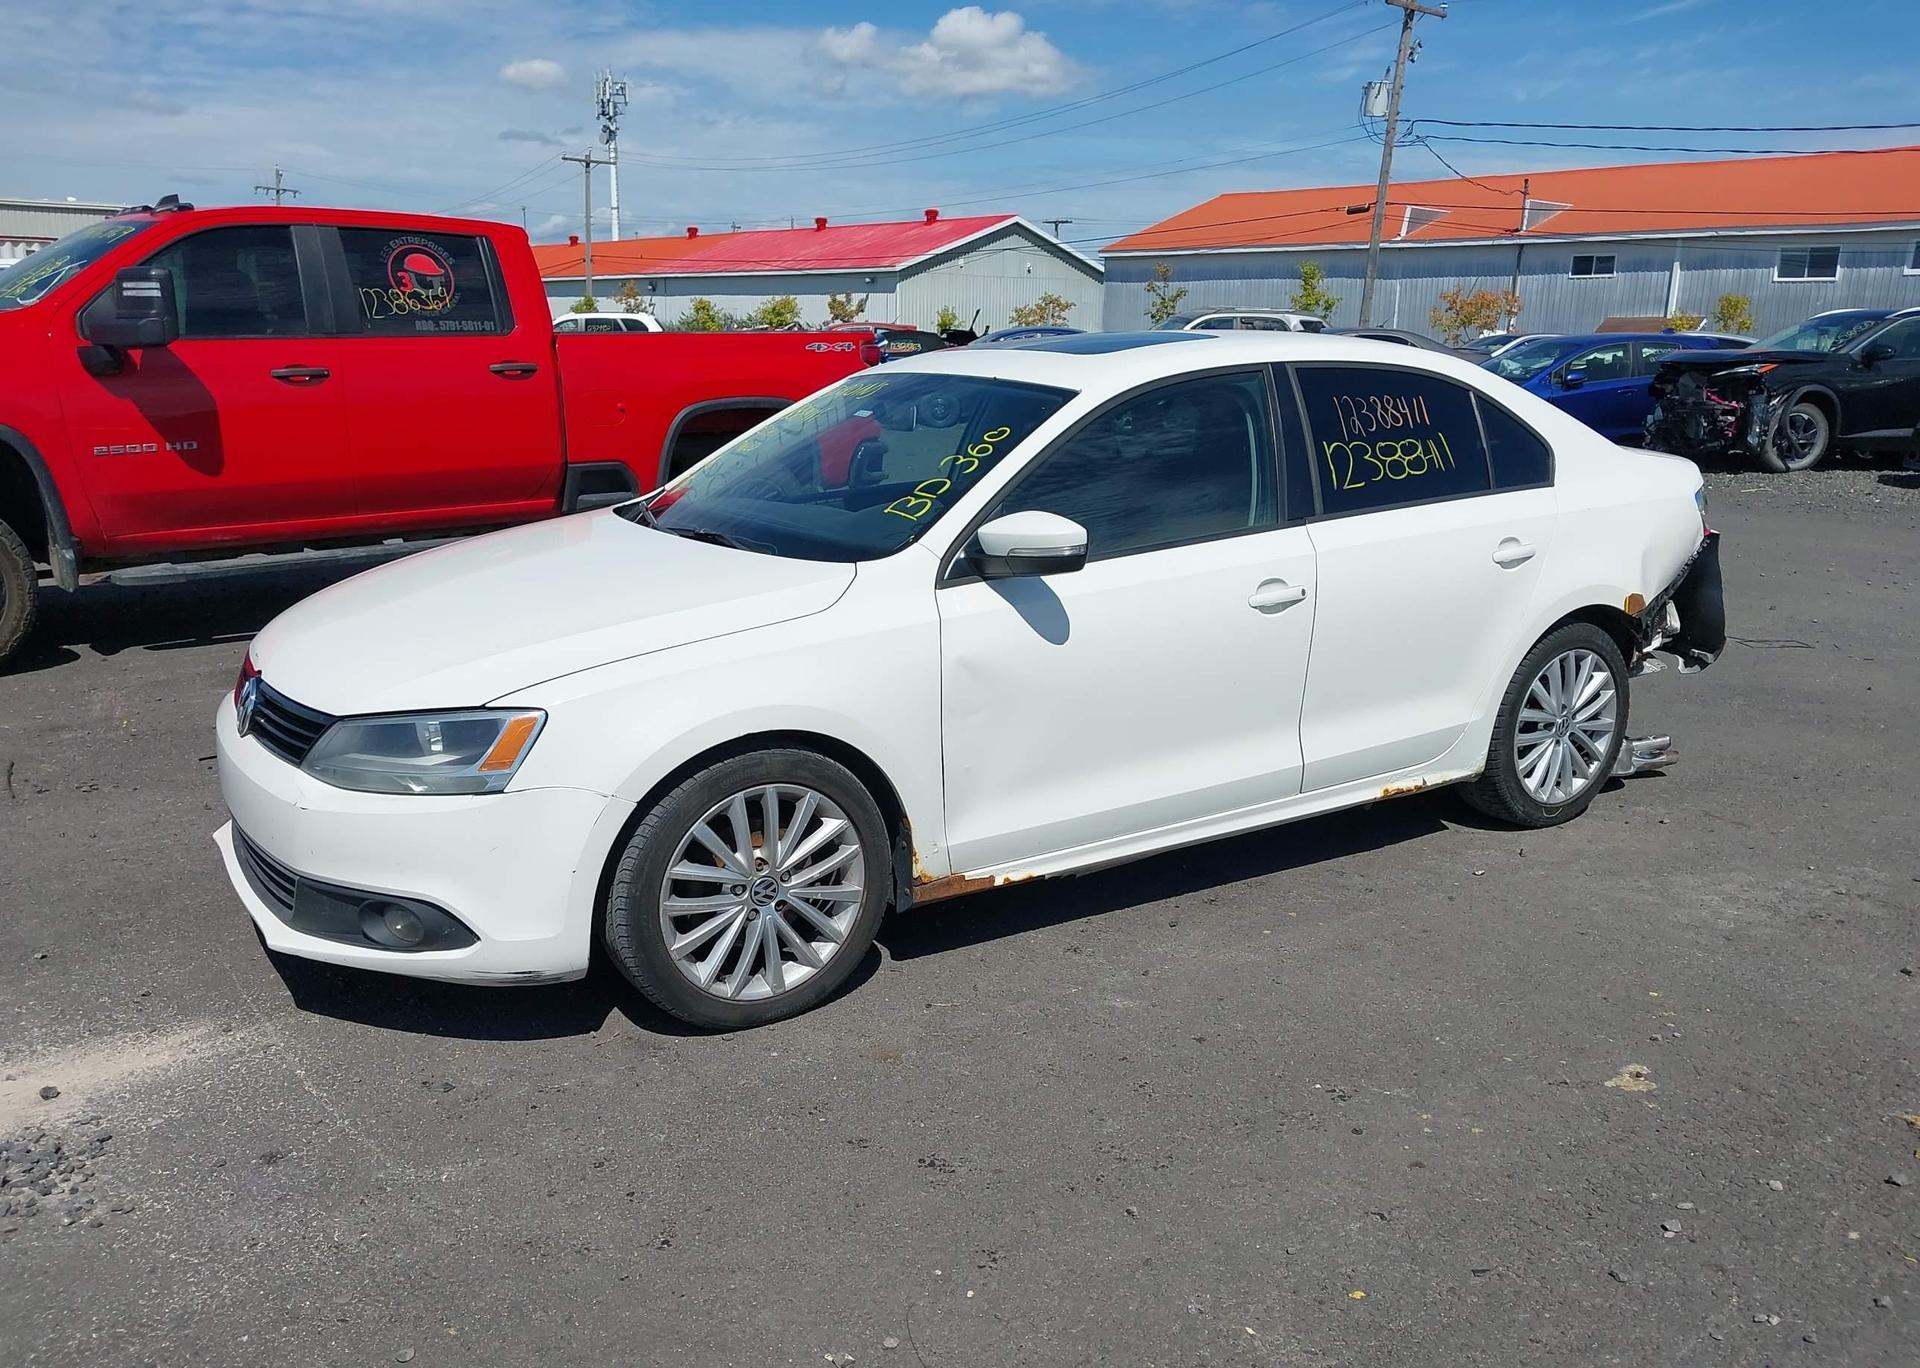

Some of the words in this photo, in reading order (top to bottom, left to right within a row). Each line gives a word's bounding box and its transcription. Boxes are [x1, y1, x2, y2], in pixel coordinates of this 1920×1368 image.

[390, 236, 456, 265] ENTREPRISES
[1333, 395, 1431, 442] 12388411
[94, 443, 158, 456] 2500
[165, 441, 198, 452] HD
[883, 478, 952, 521] BD
[939, 426, 1011, 474] 360
